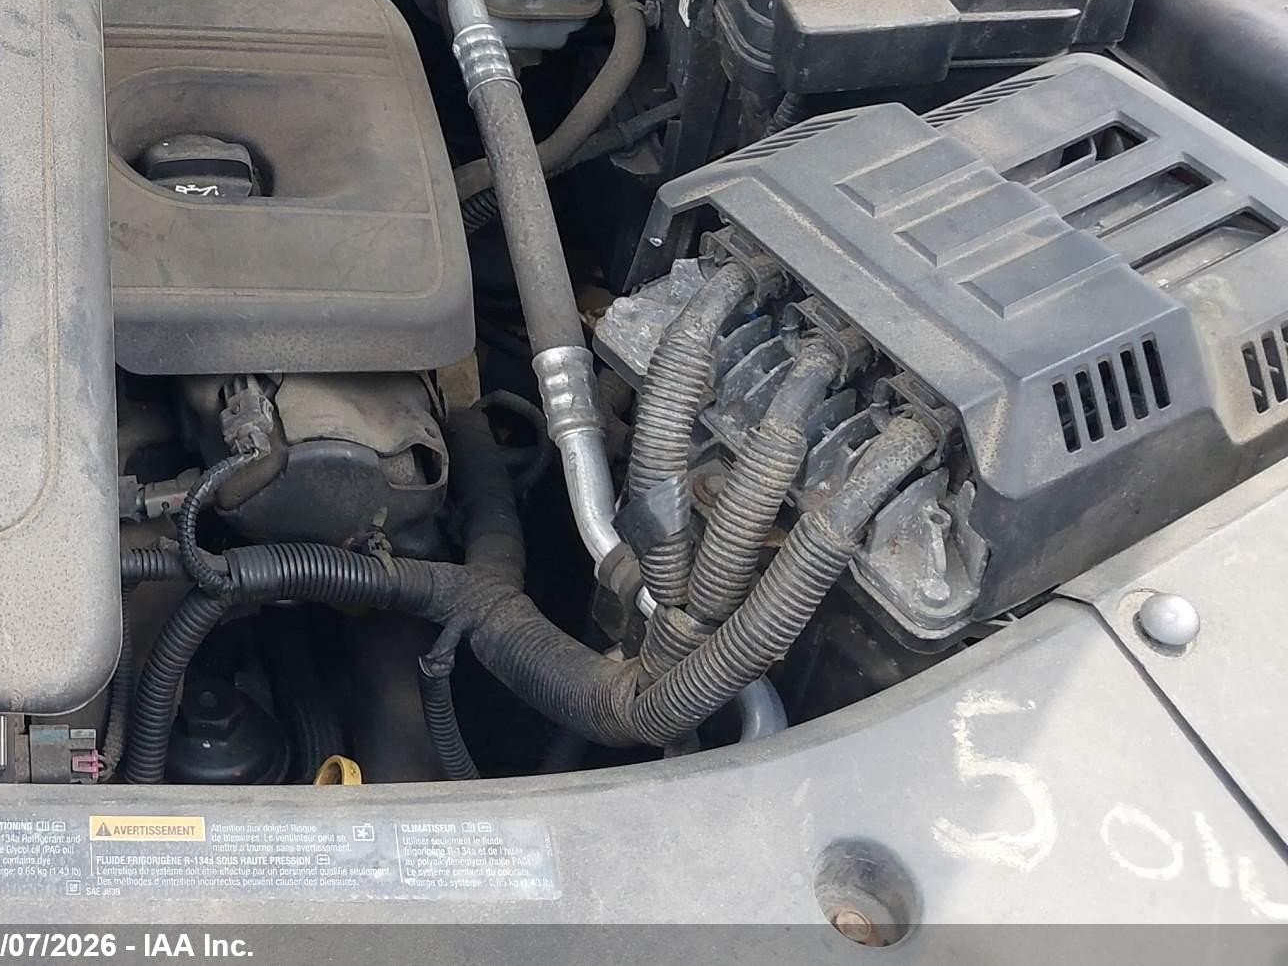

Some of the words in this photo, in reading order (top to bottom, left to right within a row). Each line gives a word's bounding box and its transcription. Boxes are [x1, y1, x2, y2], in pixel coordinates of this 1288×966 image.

[930, 688, 1058, 873] 5
[114, 825, 196, 836] AVERTISSEMENT
[402, 823, 457, 833] CLIMATISEUR
[96, 856, 126, 865] FLUIDE
[185, 856, 214, 866] R-134a
[216, 856, 239, 866] SOUS
[240, 856, 268, 866] HAUTE
[270, 856, 311, 866] PRESSION
[86, 888, 101, 896] SAE
